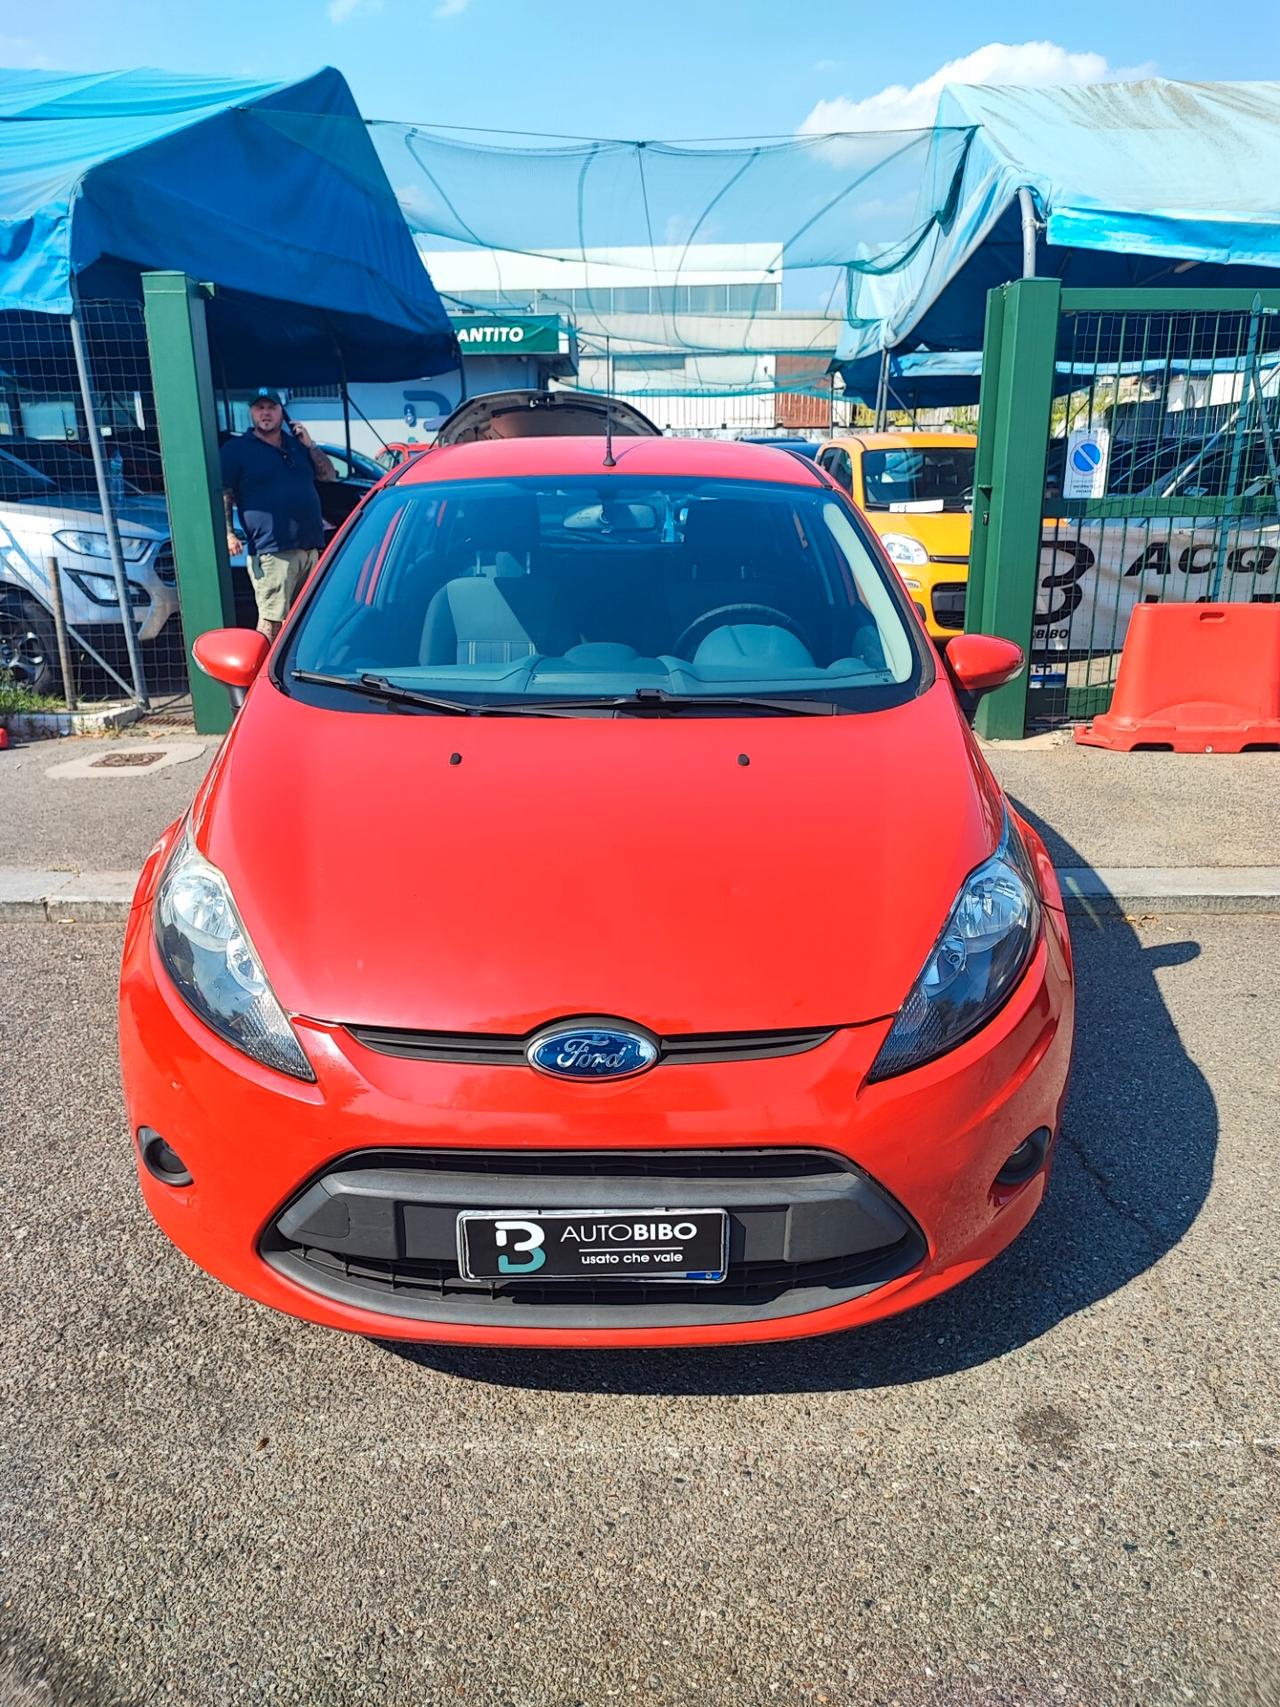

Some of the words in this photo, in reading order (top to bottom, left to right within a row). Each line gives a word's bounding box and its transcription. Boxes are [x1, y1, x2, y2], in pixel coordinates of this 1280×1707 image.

[455, 326, 525, 343] ANTITO
[556, 1038, 628, 1068] Ford
[560, 1222, 698, 1243] AUTOBIBO
[581, 1253, 620, 1265] usato
[624, 1252, 650, 1264] che
[653, 1252, 684, 1263] vale
